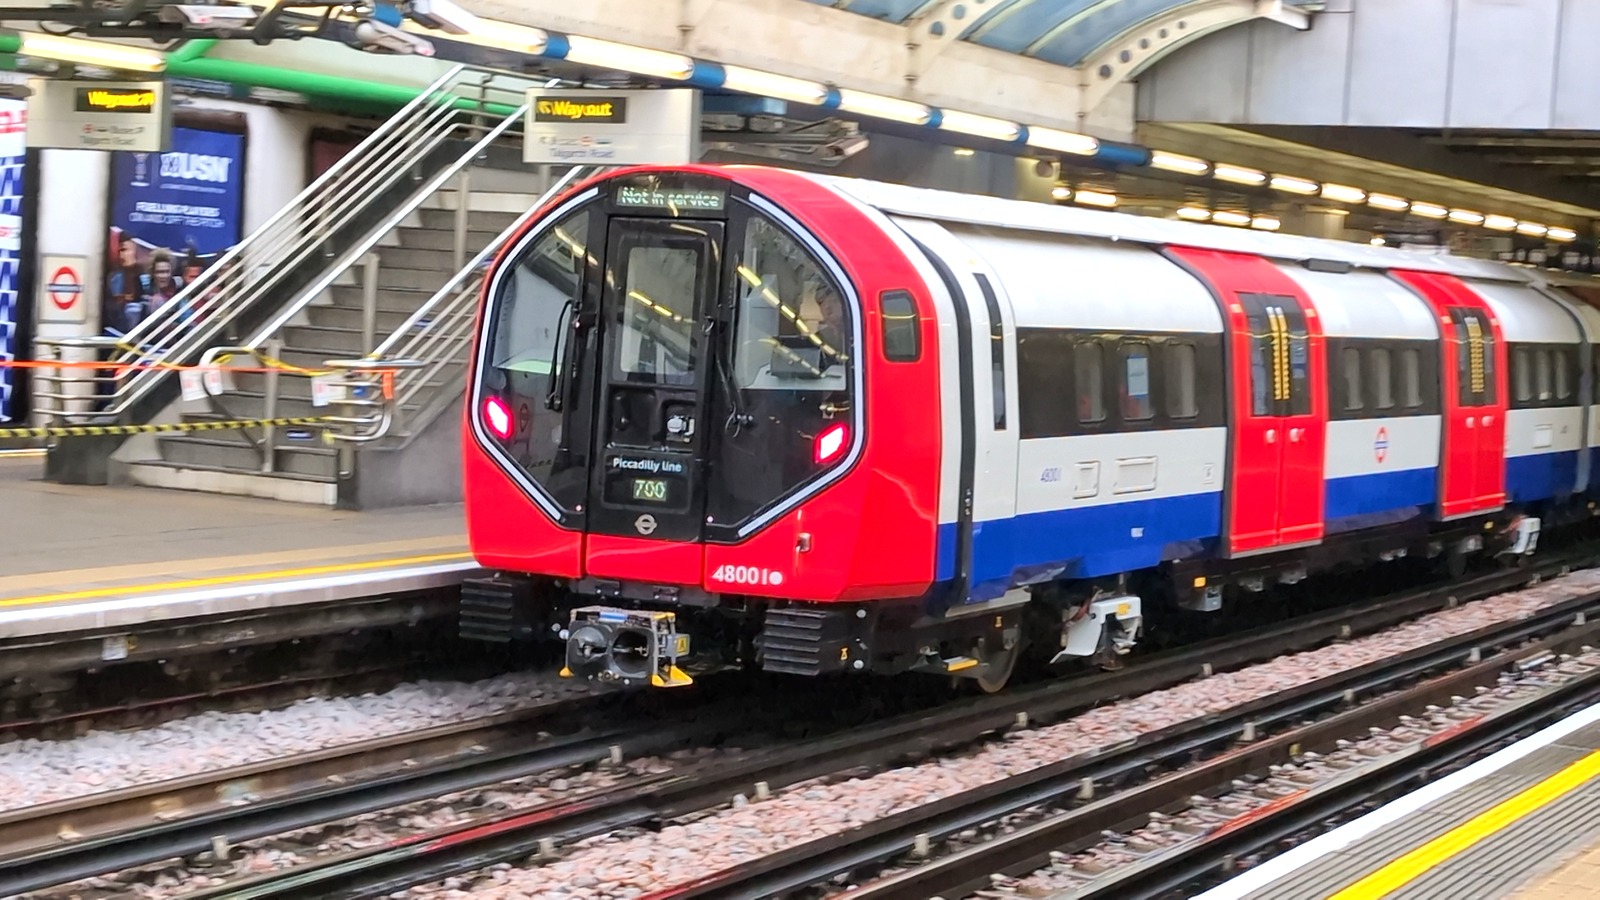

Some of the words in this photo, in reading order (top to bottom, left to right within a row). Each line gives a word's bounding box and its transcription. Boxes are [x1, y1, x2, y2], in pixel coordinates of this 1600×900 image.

[552, 101, 584, 119] Way
[584, 103, 613, 117] out
[179, 152, 230, 183] USN
[622, 187, 649, 204] Not
[651, 192, 664, 205] in
[667, 191, 720, 207] service
[612, 457, 660, 473] Piccadilly
[661, 461, 682, 472] line
[634, 479, 666, 499] 700
[711, 564, 768, 585] 48001
